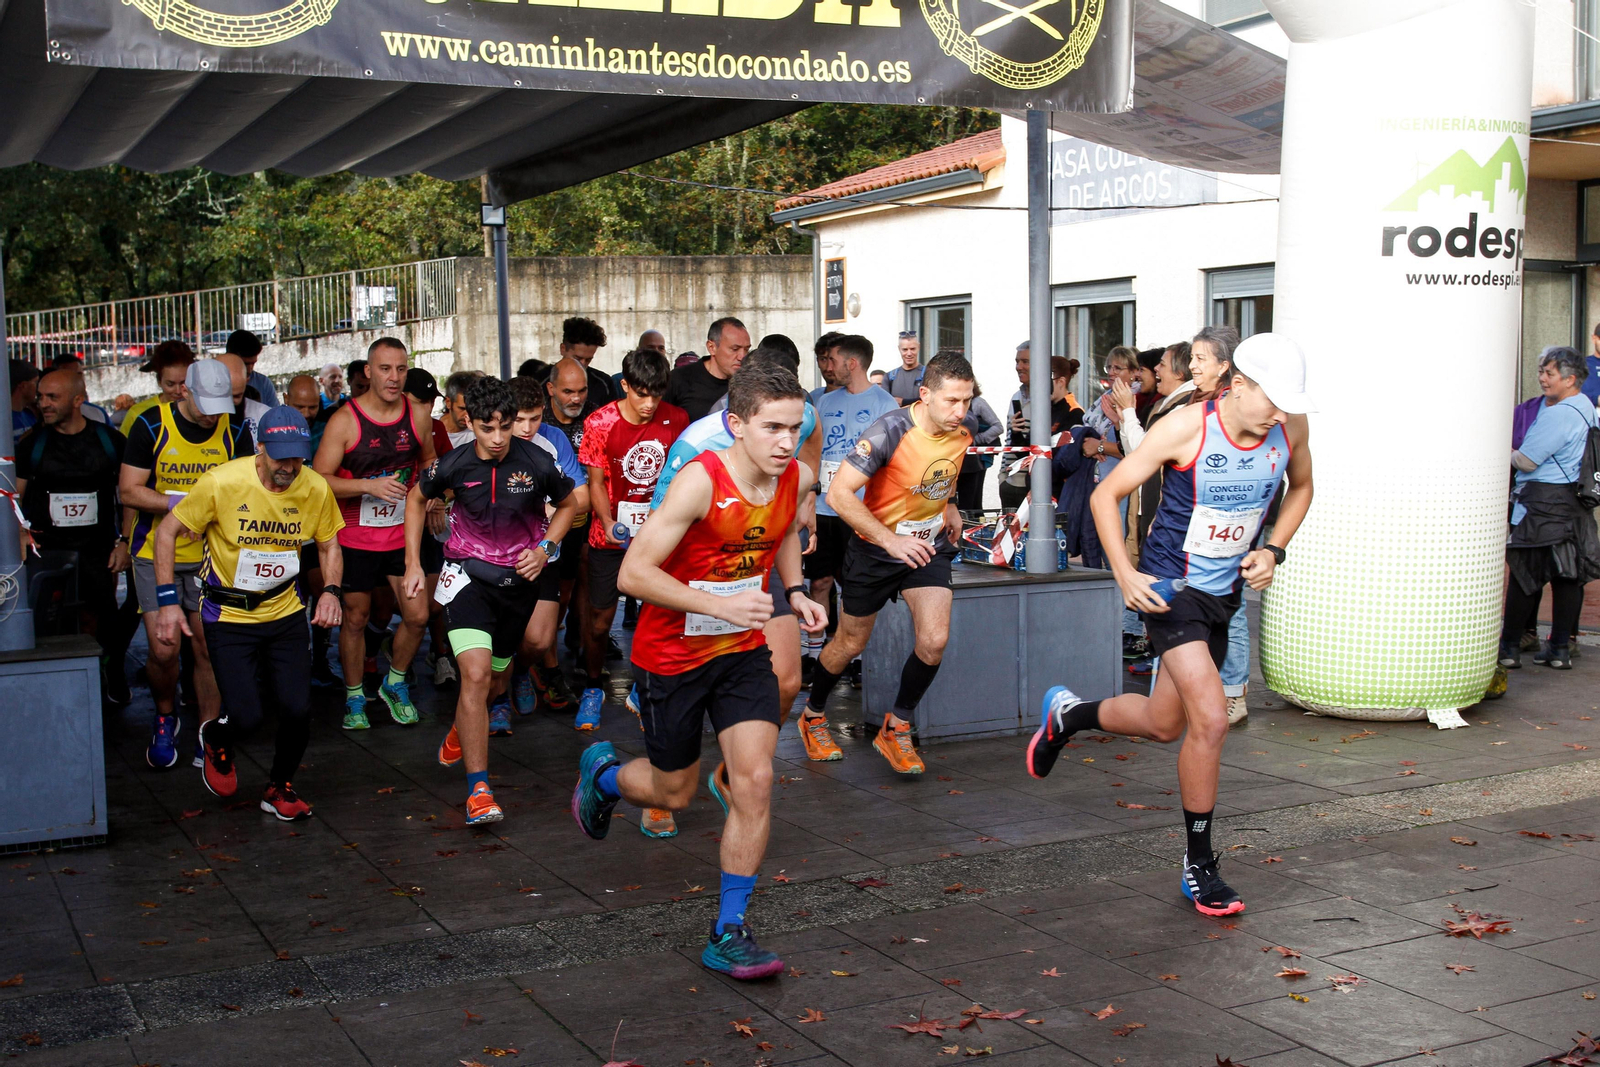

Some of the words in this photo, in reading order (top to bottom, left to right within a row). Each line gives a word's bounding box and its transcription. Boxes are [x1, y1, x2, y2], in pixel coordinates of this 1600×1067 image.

[381, 31, 912, 84] www.caminhantesdocondado.es
[1048, 146, 1091, 181] ASA
[1069, 181, 1095, 213] DE
[1099, 168, 1172, 210] ARCOS
[1208, 484, 1254, 493] CONCELLO
[1213, 494, 1225, 502] DE
[1226, 493, 1247, 501] VIGO
[62, 504, 88, 517] 137
[371, 504, 397, 518] 147
[629, 512, 649, 525] 13
[238, 518, 302, 535] TANINOS
[1208, 525, 1245, 542] 140
[237, 535, 302, 548] PONTEAREAS
[254, 563, 285, 578] 150
[440, 570, 456, 588] 46
